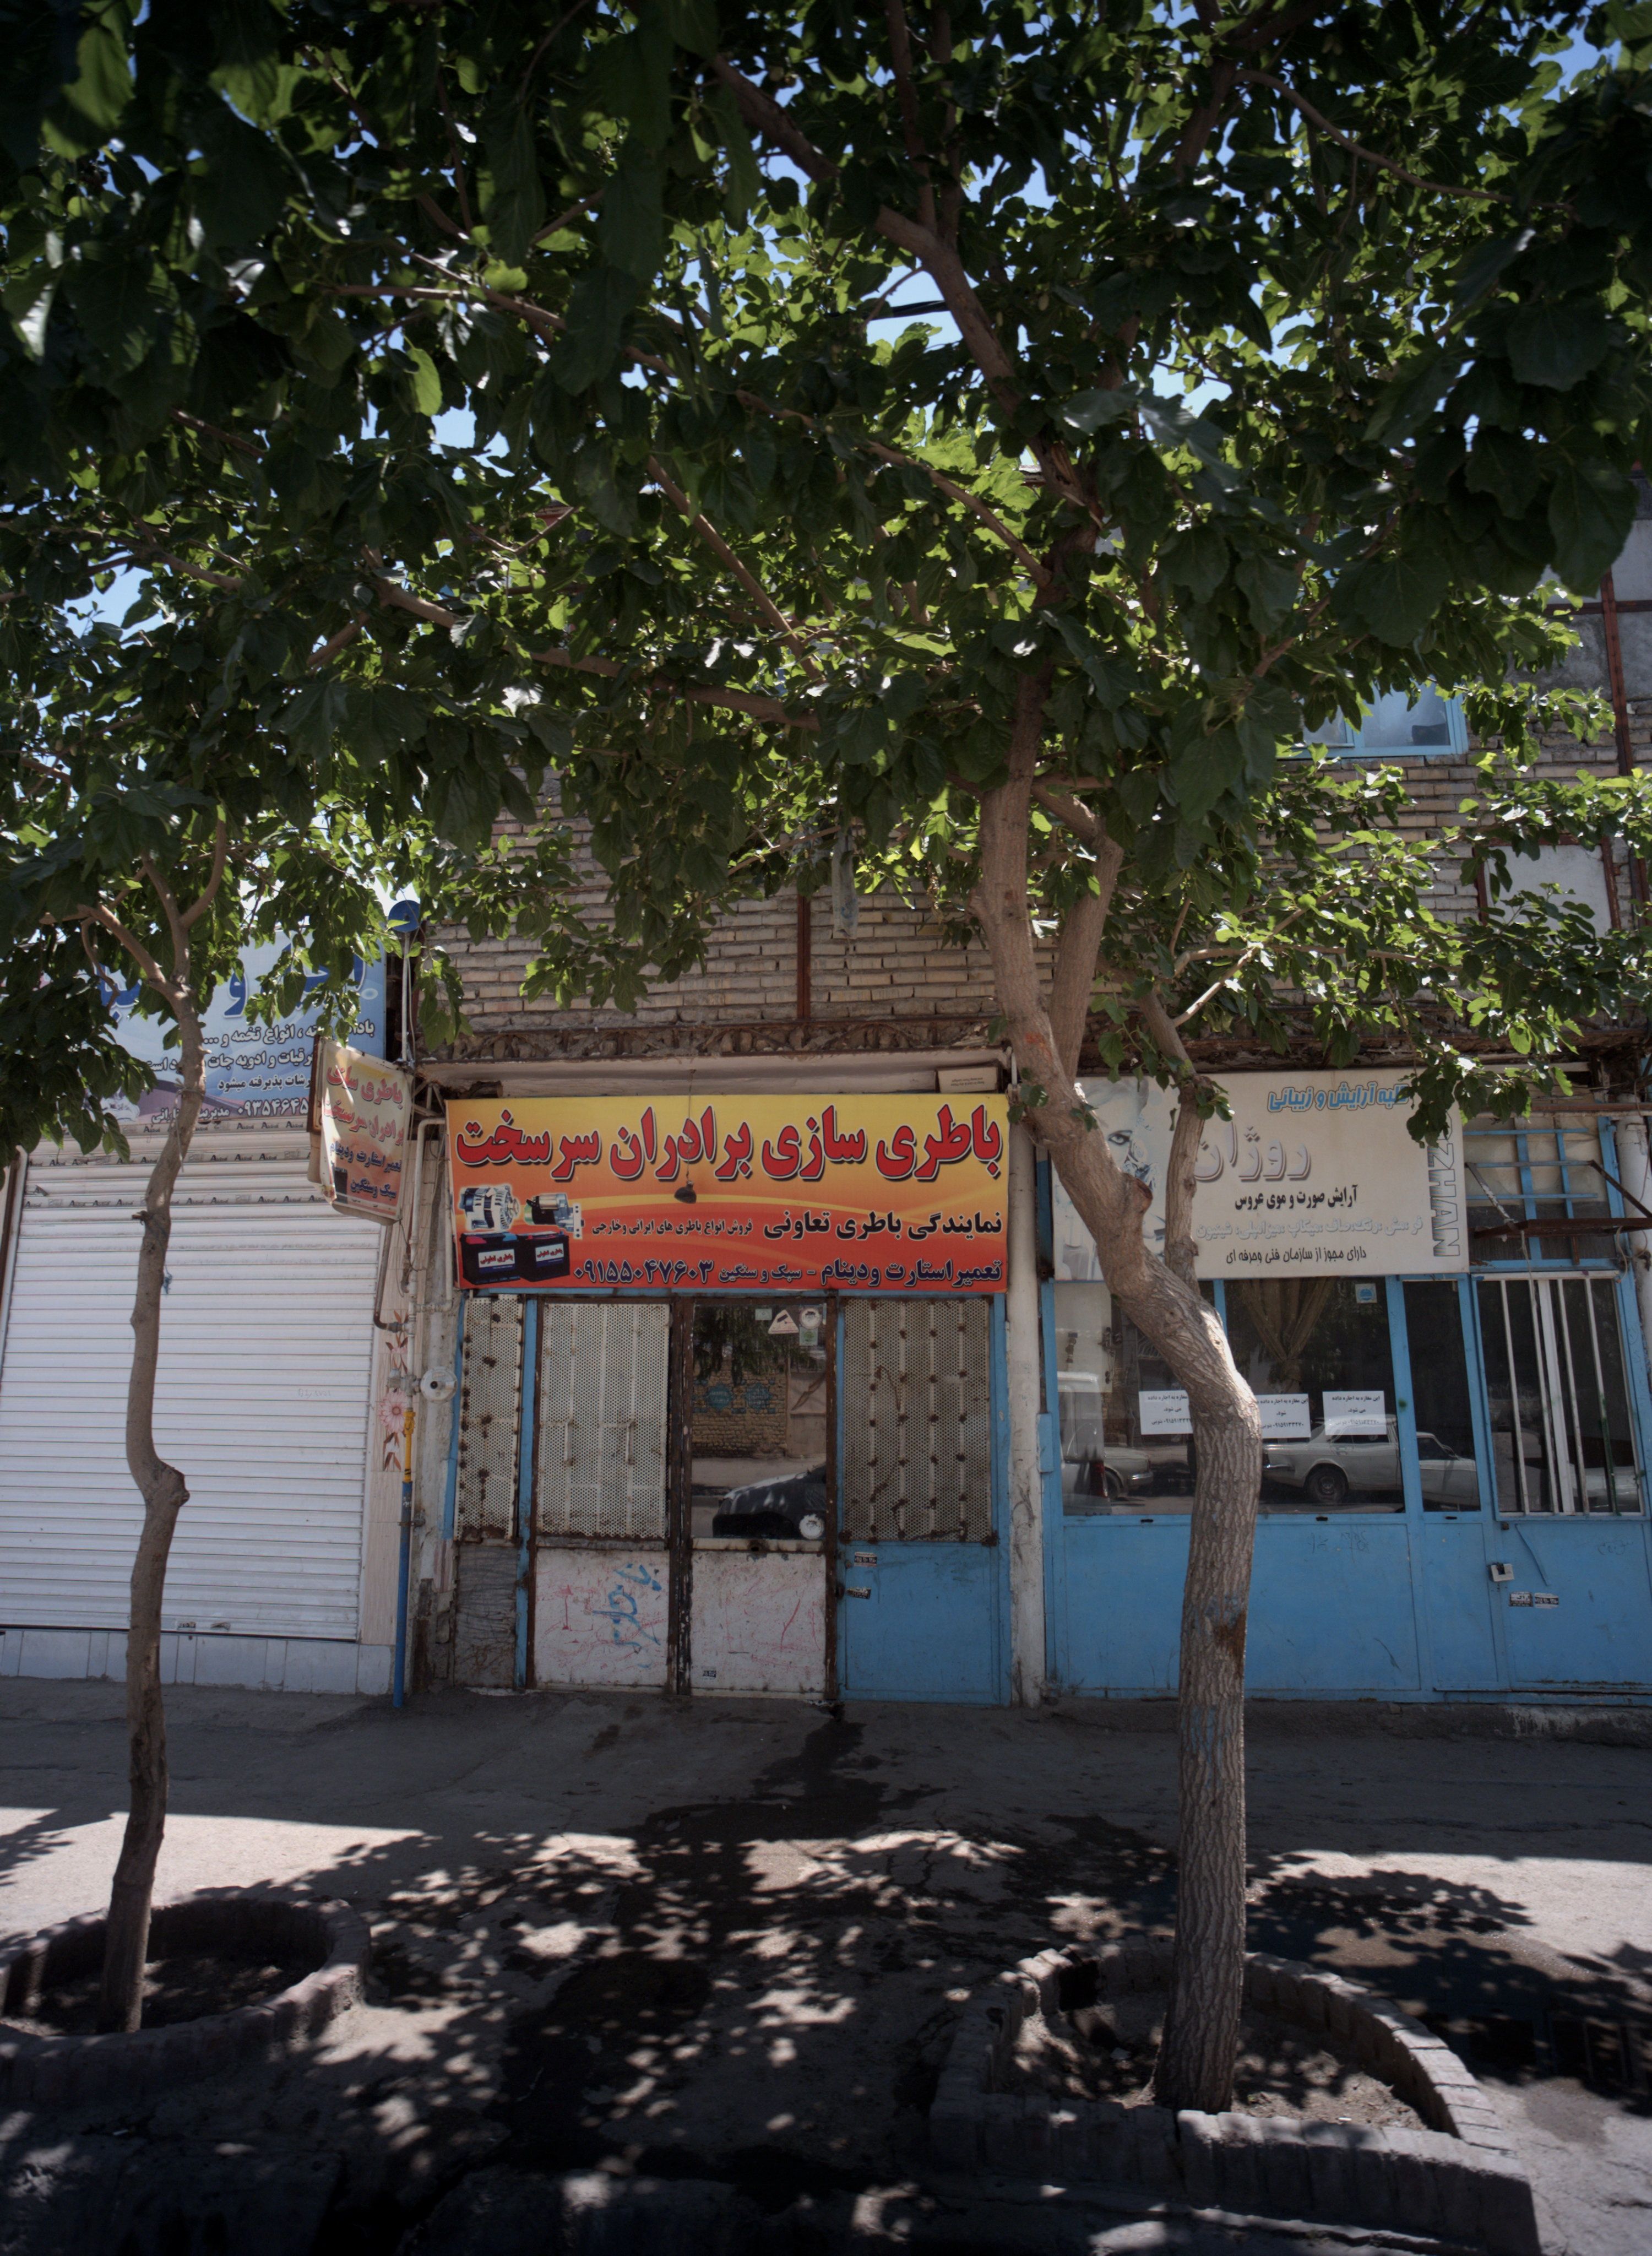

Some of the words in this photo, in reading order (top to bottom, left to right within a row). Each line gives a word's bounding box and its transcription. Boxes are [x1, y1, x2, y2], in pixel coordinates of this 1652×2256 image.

[221, 1033, 230, 1047] و
[231, 1027, 262, 1043] تخمه
[263, 1023, 295, 1044] انواع
[208, 1053, 234, 1070] جات
[236, 1050, 267, 1070] ادویه
[268, 1055, 275, 1068] و
[277, 1048, 313, 1066] رقیات
[249, 1075, 283, 1092] پذیرفته
[360, 1077, 403, 1110] باطری
[1314, 1090, 1327, 1111] و
[1328, 1082, 1378, 1111] آرایش
[609, 1105, 753, 1180] برادران
[762, 1104, 867, 1180] سازی
[876, 1103, 1003, 1180] باطری
[1194, 1120, 1312, 1183] روژان
[1427, 1108, 1460, 1257] ZHAN
[1235, 1191, 1264, 1211] عروس
[1267, 1194, 1286, 1210] موی
[1289, 1196, 1295, 1209] و
[1296, 1190, 1325, 1208] صورت
[1328, 1184, 1358, 1208] آرایش
[629, 1219, 654, 1236] ایرانی
[656, 1219, 673, 1236] های
[675, 1219, 702, 1236] باطری
[704, 1219, 725, 1236] انواع
[727, 1218, 753, 1236] فروش
[764, 1211, 830, 1240] تعاونی
[836, 1211, 902, 1240] باطری
[907, 1211, 1003, 1241] نمایندگی
[1265, 1248, 1280, 1264] فنی
[1283, 1248, 1313, 1263] سازمان
[1316, 1247, 1322, 1262] از
[1324, 1247, 1344, 1262] مجوز
[1346, 1246, 1367, 1261] دارای
[718, 1263, 758, 1282] سنگین
[760, 1270, 769, 1282] و
[770, 1264, 802, 1282] سبک
